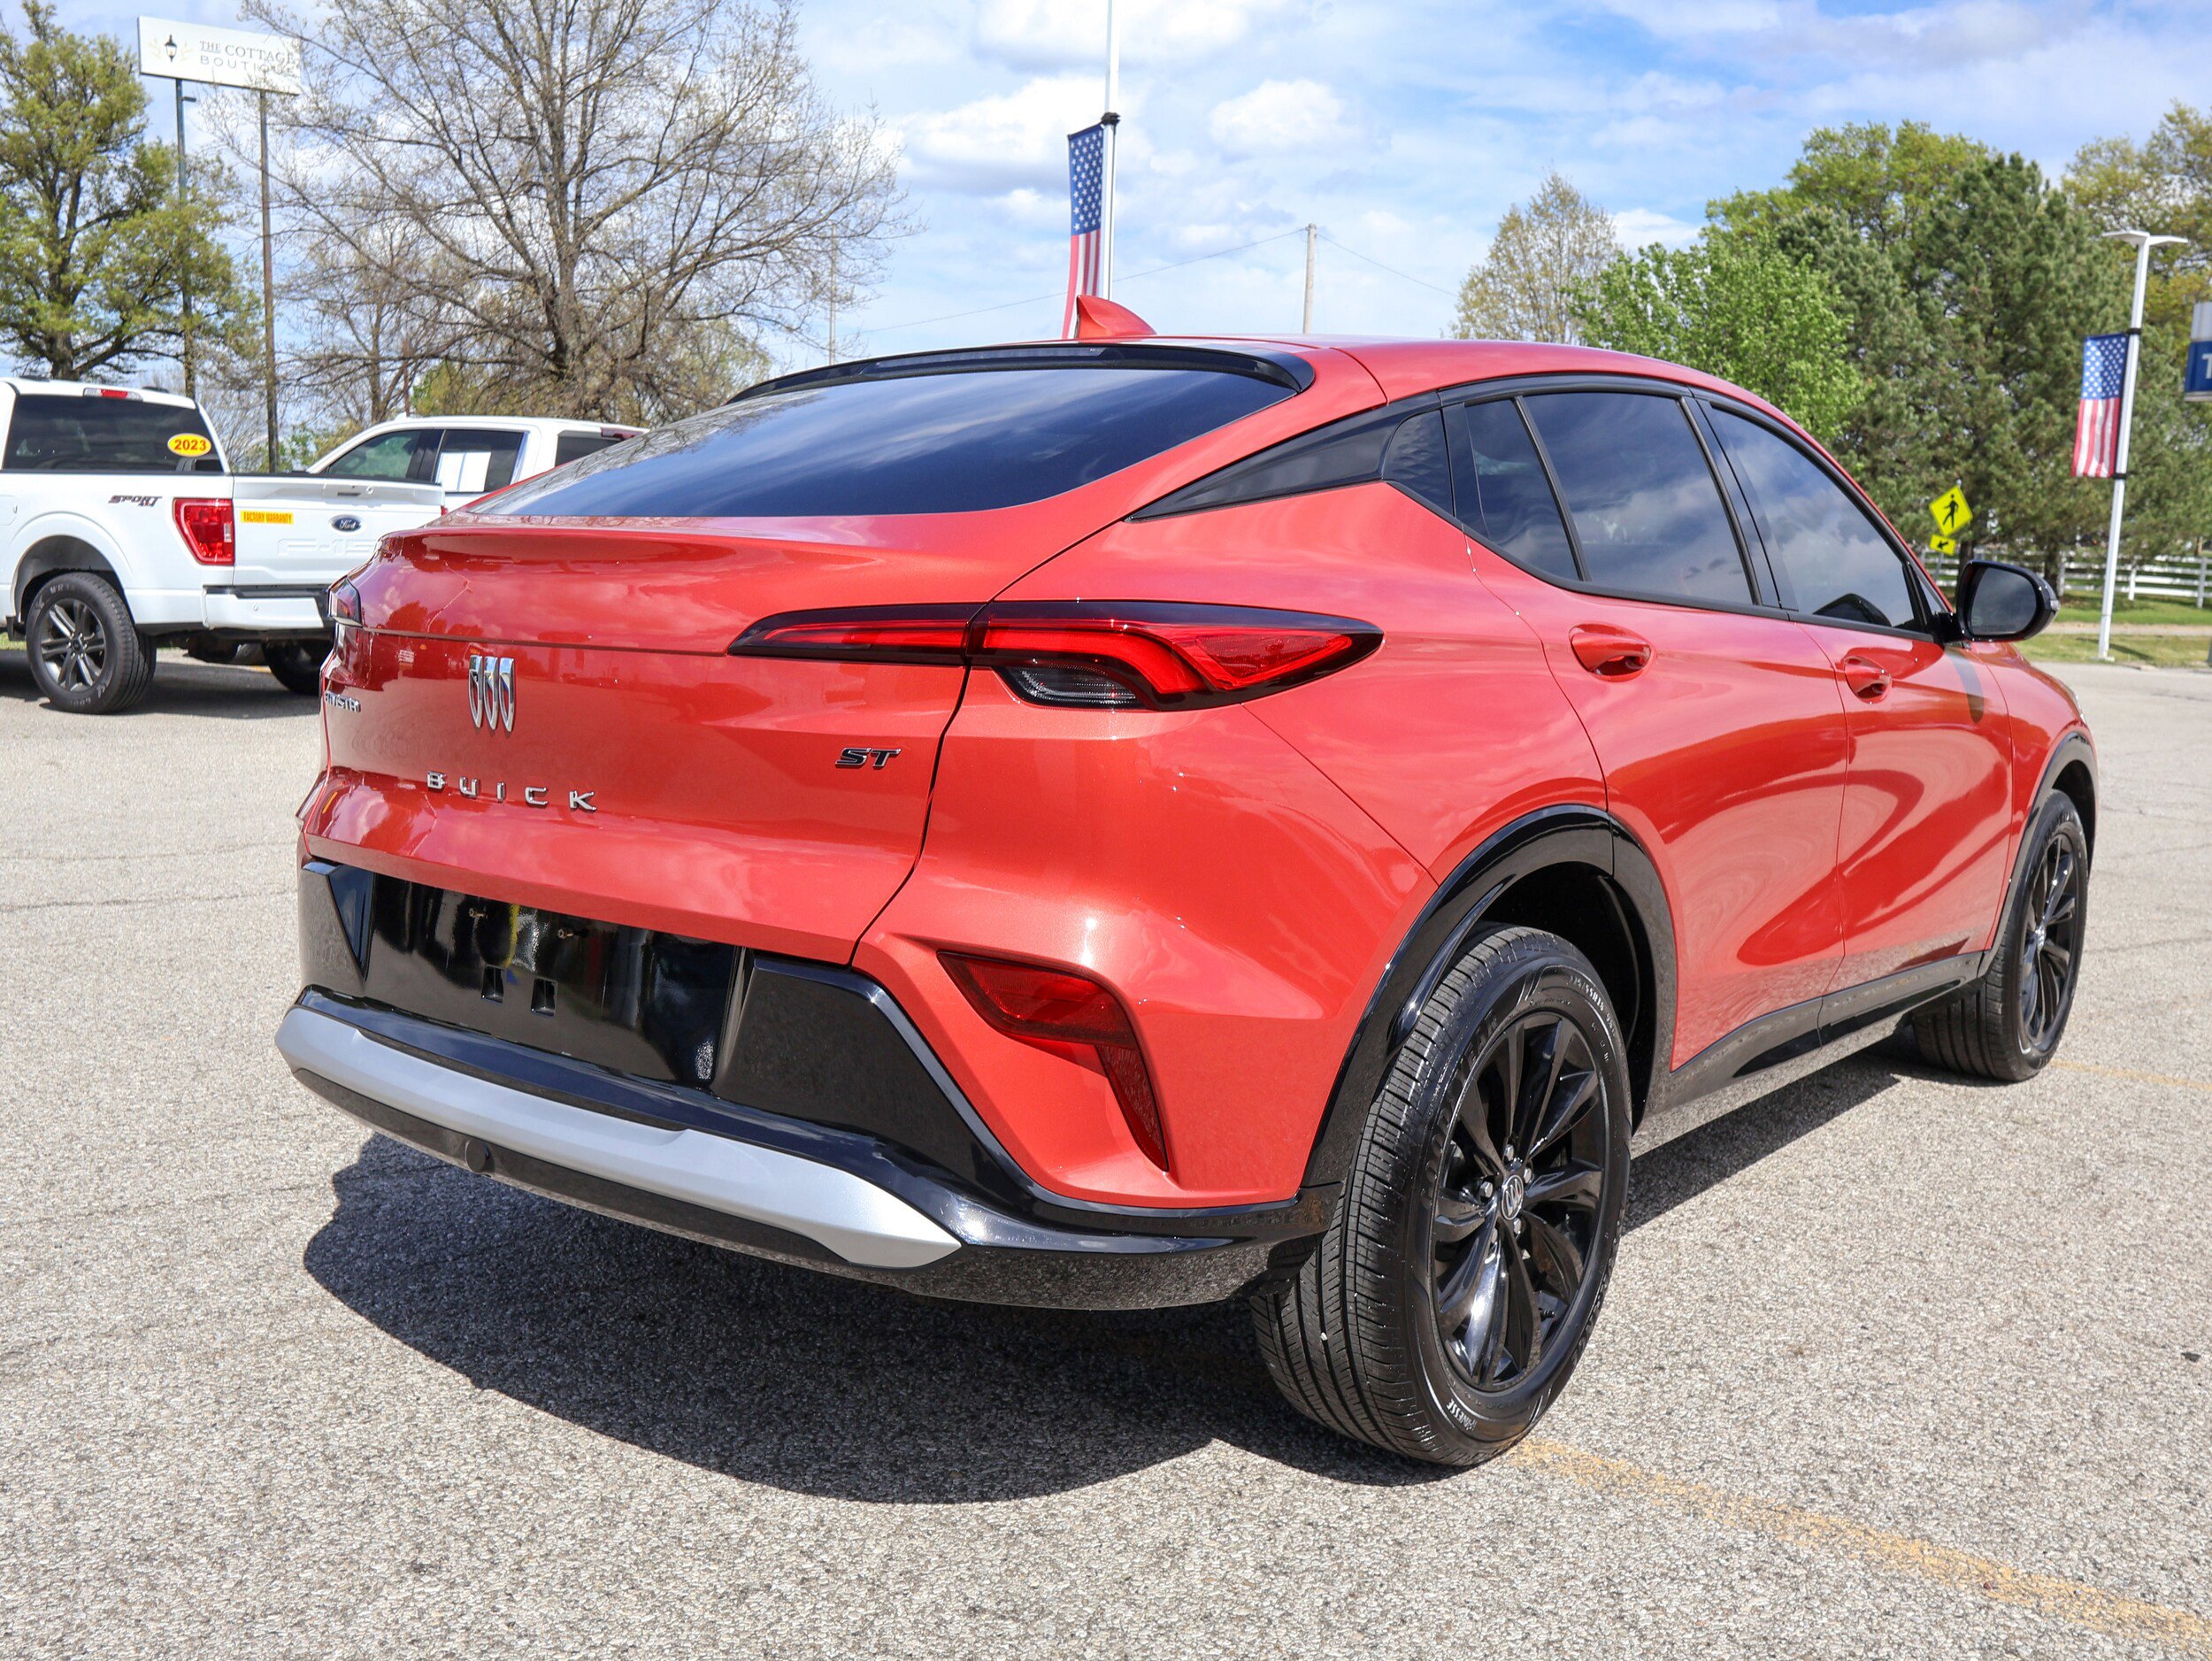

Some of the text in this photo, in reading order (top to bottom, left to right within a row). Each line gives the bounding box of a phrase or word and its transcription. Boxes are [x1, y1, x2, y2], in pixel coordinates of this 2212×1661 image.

[199, 40, 296, 65] THE COTTAGE
[200, 55, 298, 78] BOUTIQUE
[173, 438, 207, 451] 2023
[107, 495, 163, 507] SPORT
[278, 538, 376, 557] F-15
[834, 747, 902, 768] ST
[426, 771, 597, 812] BUICK
